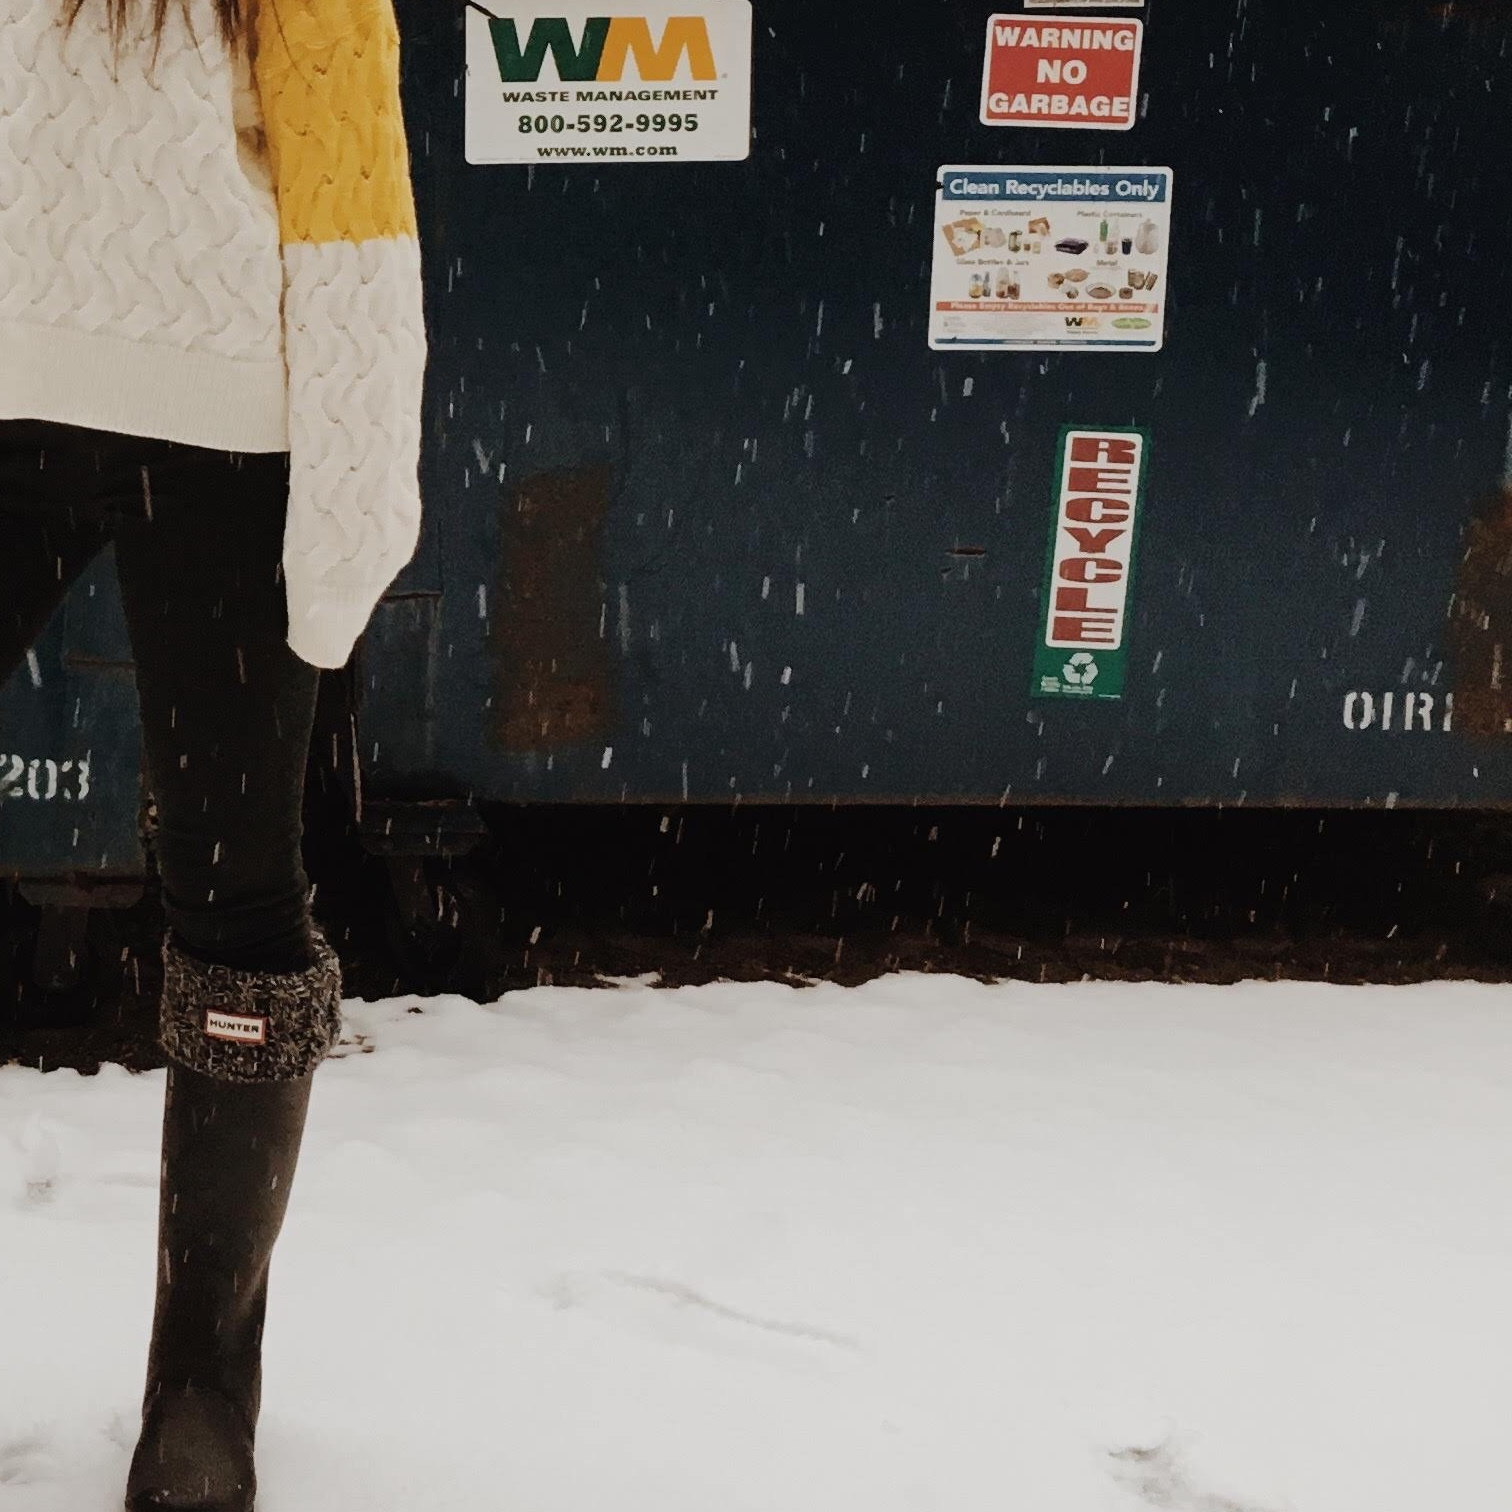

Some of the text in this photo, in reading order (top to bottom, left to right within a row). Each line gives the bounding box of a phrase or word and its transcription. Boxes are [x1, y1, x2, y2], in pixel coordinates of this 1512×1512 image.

[488, 16, 717, 82] WM
[995, 25, 1135, 51] WARNING
[1036, 59, 1087, 85] NO
[502, 89, 719, 103] WASTE MANAGEMENT
[989, 92, 1130, 117] GARBAGE
[518, 113, 699, 134] 800-592-9995
[536, 144, 678, 157] www.wm.com
[949, 178, 1159, 201] Clean Recyclables Only
[1052, 437, 1136, 643] RECYCLE
[209, 1019, 259, 1033] HUNTER
